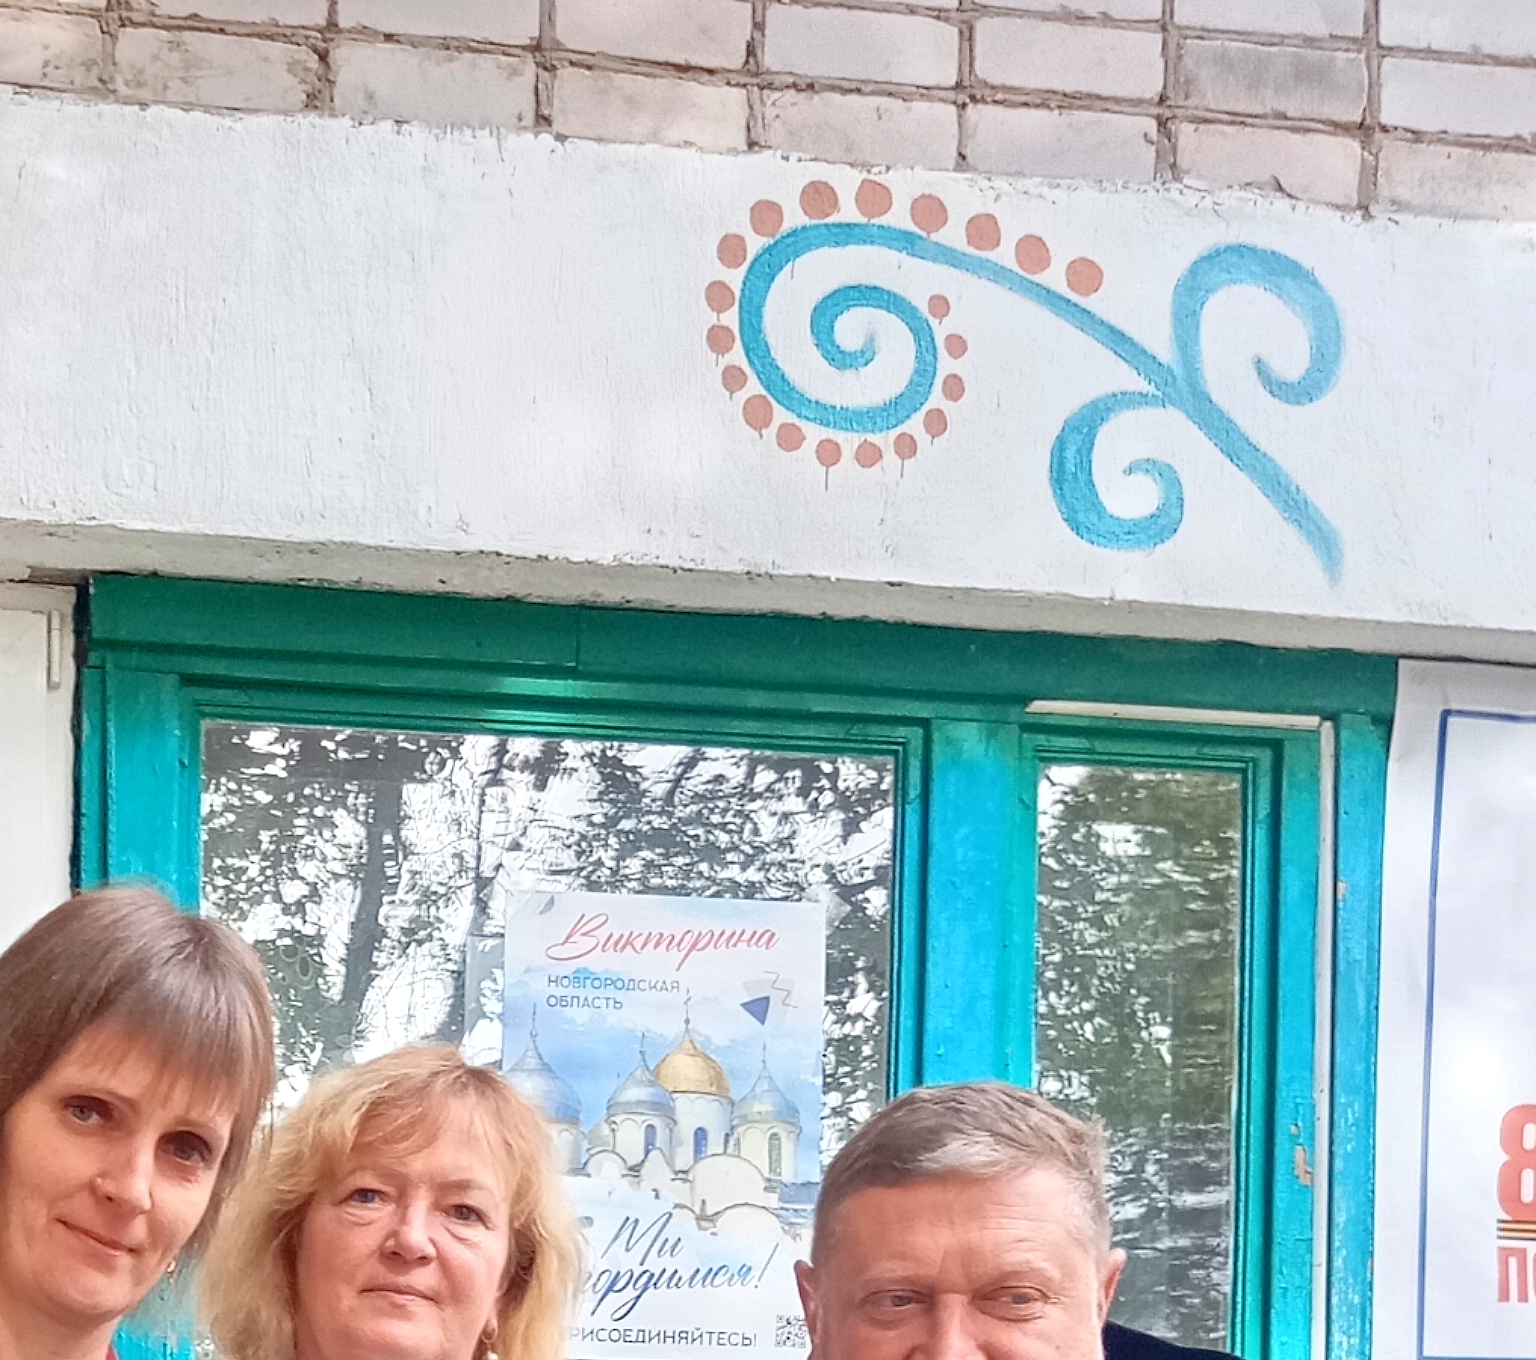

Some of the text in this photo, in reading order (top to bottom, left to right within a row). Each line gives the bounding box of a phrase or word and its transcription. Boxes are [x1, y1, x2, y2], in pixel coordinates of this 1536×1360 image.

[545, 913, 780, 972] Викторина
[547, 975, 680, 993] НОВГОРОДСКАЯ
[546, 994, 623, 1010] ОБЛАСТЬ
[1497, 1245, 1536, 1303] П
[569, 1326, 757, 1348] РИСОЕДИНЯЙТЕСЬ!
